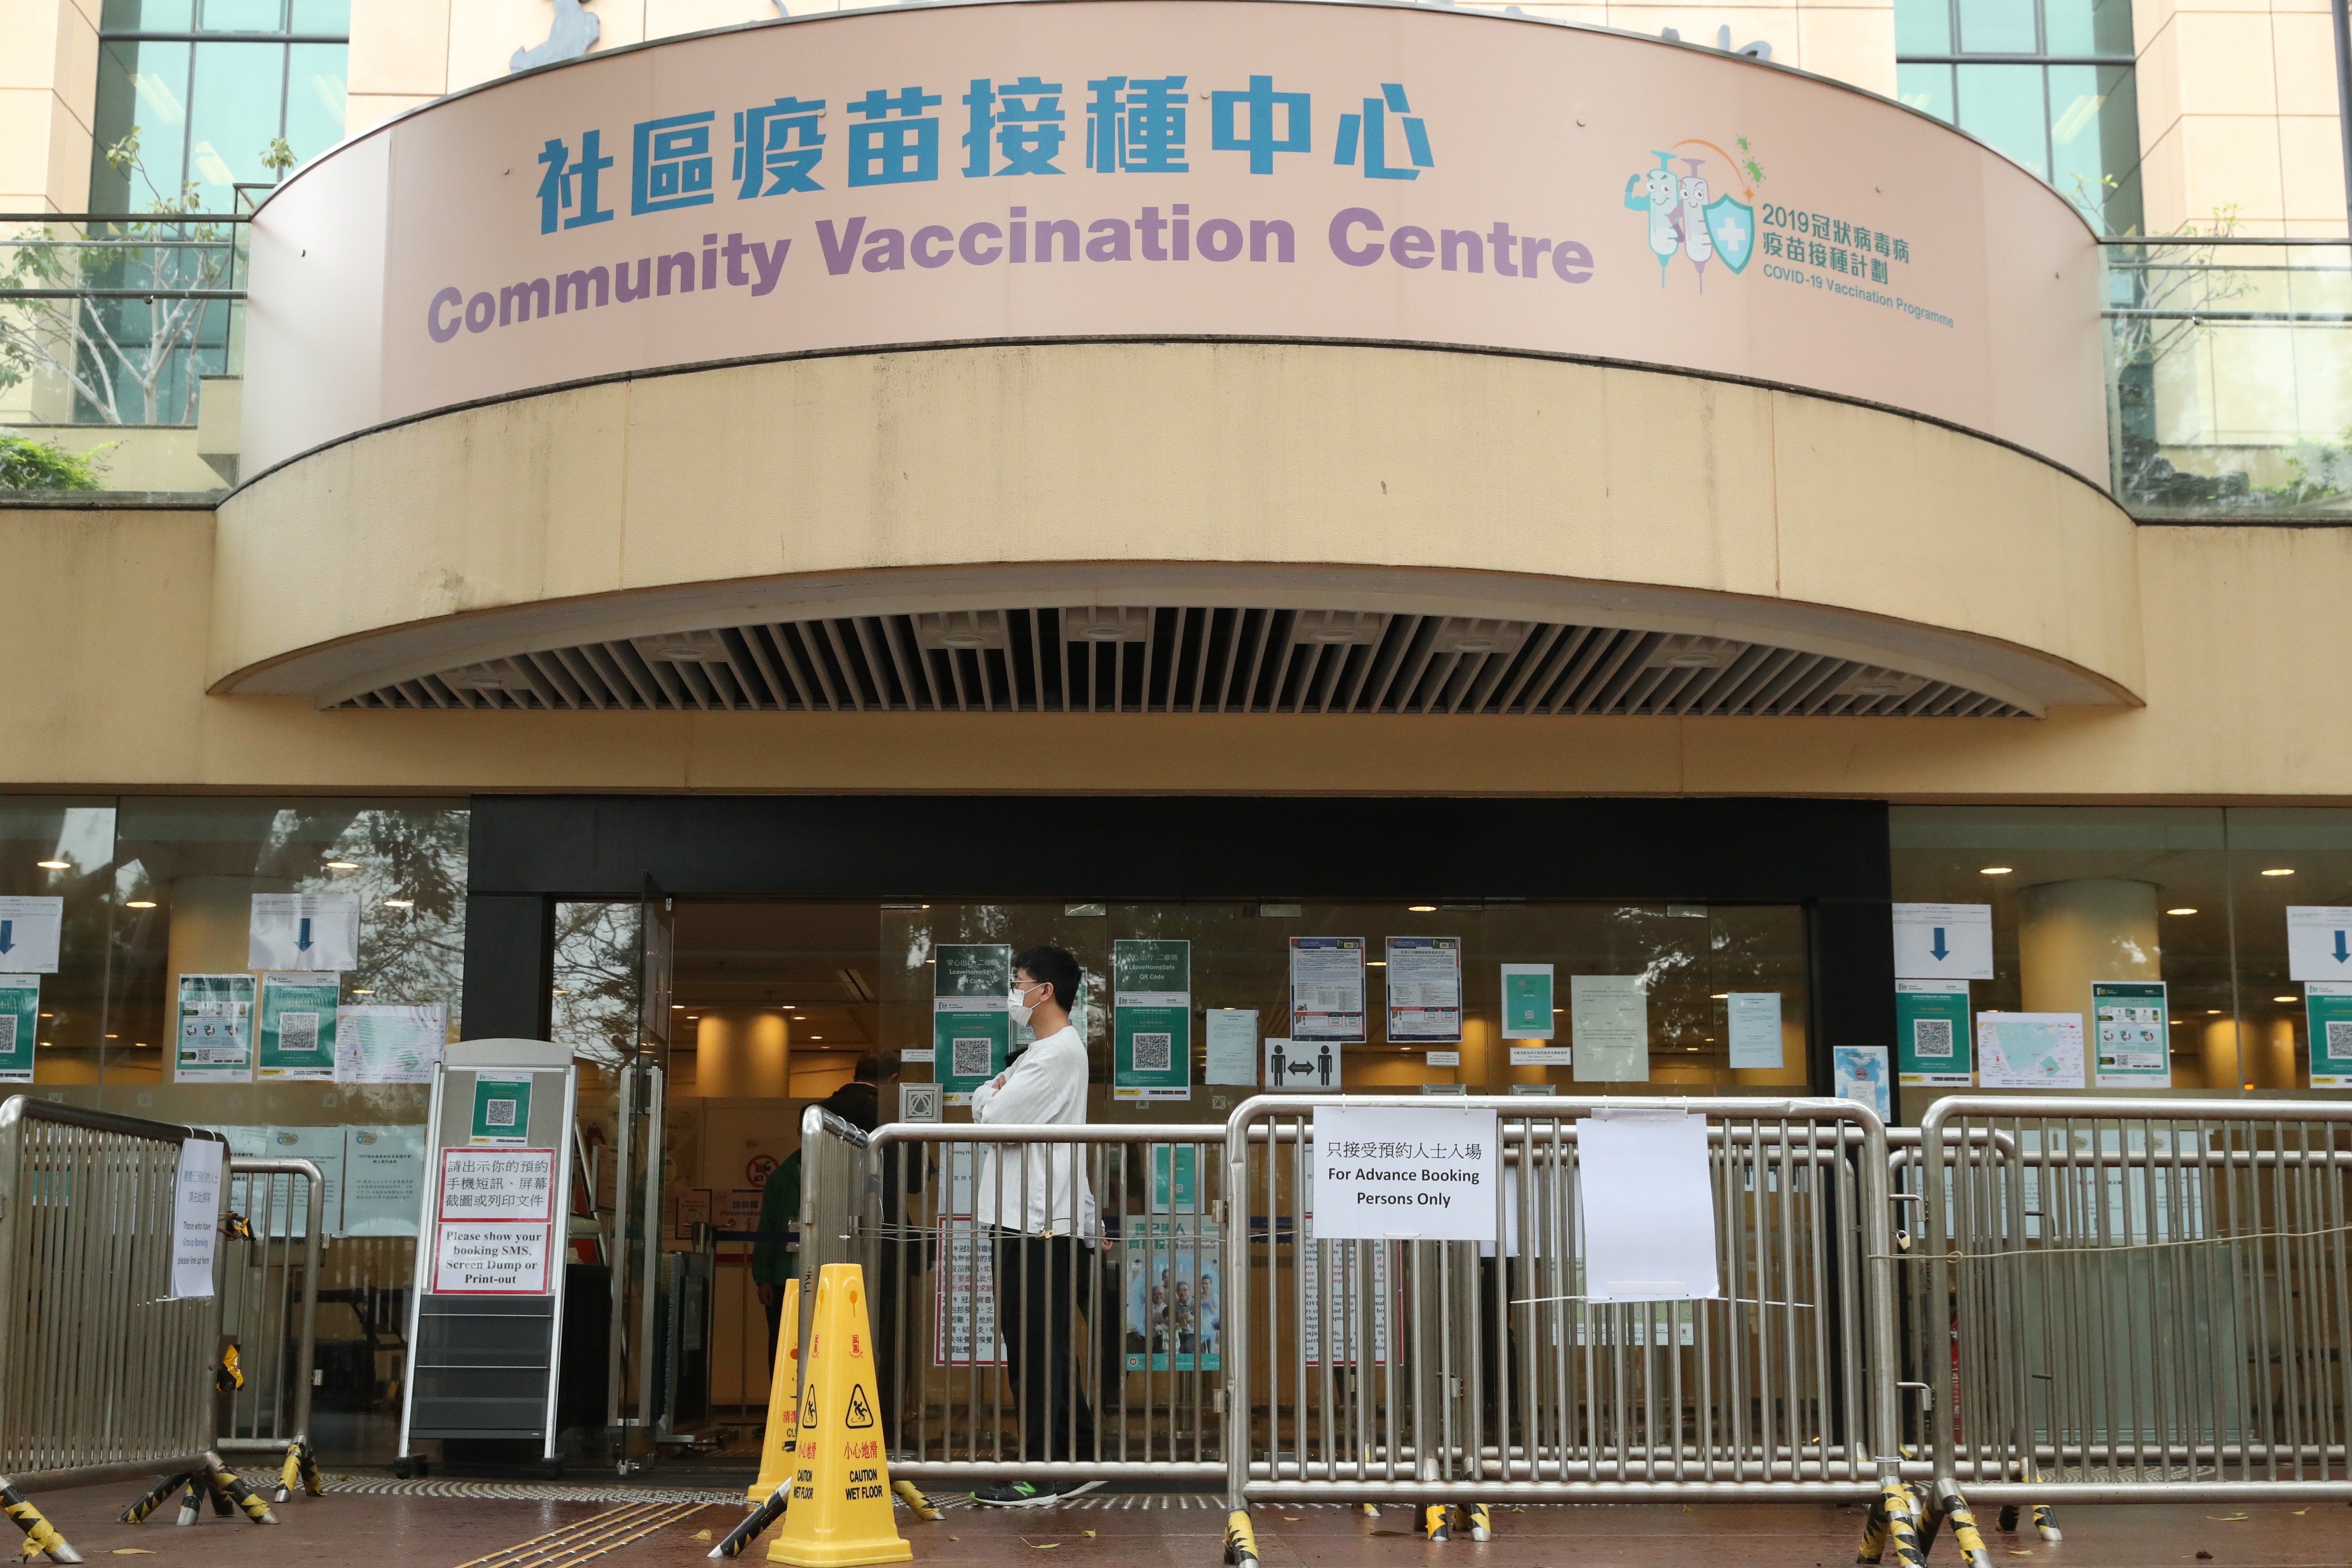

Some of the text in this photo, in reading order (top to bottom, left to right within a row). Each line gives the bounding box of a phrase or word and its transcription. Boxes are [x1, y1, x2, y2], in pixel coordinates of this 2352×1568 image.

[536, 75, 1434, 235] 社區疫苗接種中心
[1762, 203, 1910, 264] 2019冠狀病毒病
[1763, 232, 1888, 285] 疫苗接種計劃
[428, 204, 1594, 343] Community Vaccination Centre
[1764, 263, 1954, 328] COVID-19 Vaccination Programme
[1326, 1142, 1482, 1160] 只接受預約人士入場
[447, 1161, 548, 1173] 請出示你的預約
[1328, 1168, 1479, 1184] For Advance Booking
[446, 1177, 547, 1190] 手機短訊、屏幕
[445, 1194, 543, 1207] 截圖或列印文件
[1357, 1192, 1451, 1208] Persons Only
[183, 1221, 211, 1231] Those who have
[183, 1238, 208, 1248] Group Booking
[446, 1231, 542, 1243] Please show your
[453, 1246, 532, 1257] booking SMS,
[178, 1256, 189, 1265] please
[446, 1260, 483, 1269] Screen
[487, 1260, 521, 1271] Dump
[465, 1274, 516, 1283] Print-out
[798, 1441, 817, 1460] 小心地滑
[844, 1441, 878, 1460] 小心地滑
[797, 1470, 812, 1482] CAUTION
[850, 1469, 877, 1482] CAUTION
[801, 1487, 813, 1499] FLOOR
[845, 1485, 883, 1500] WET FLOOR
